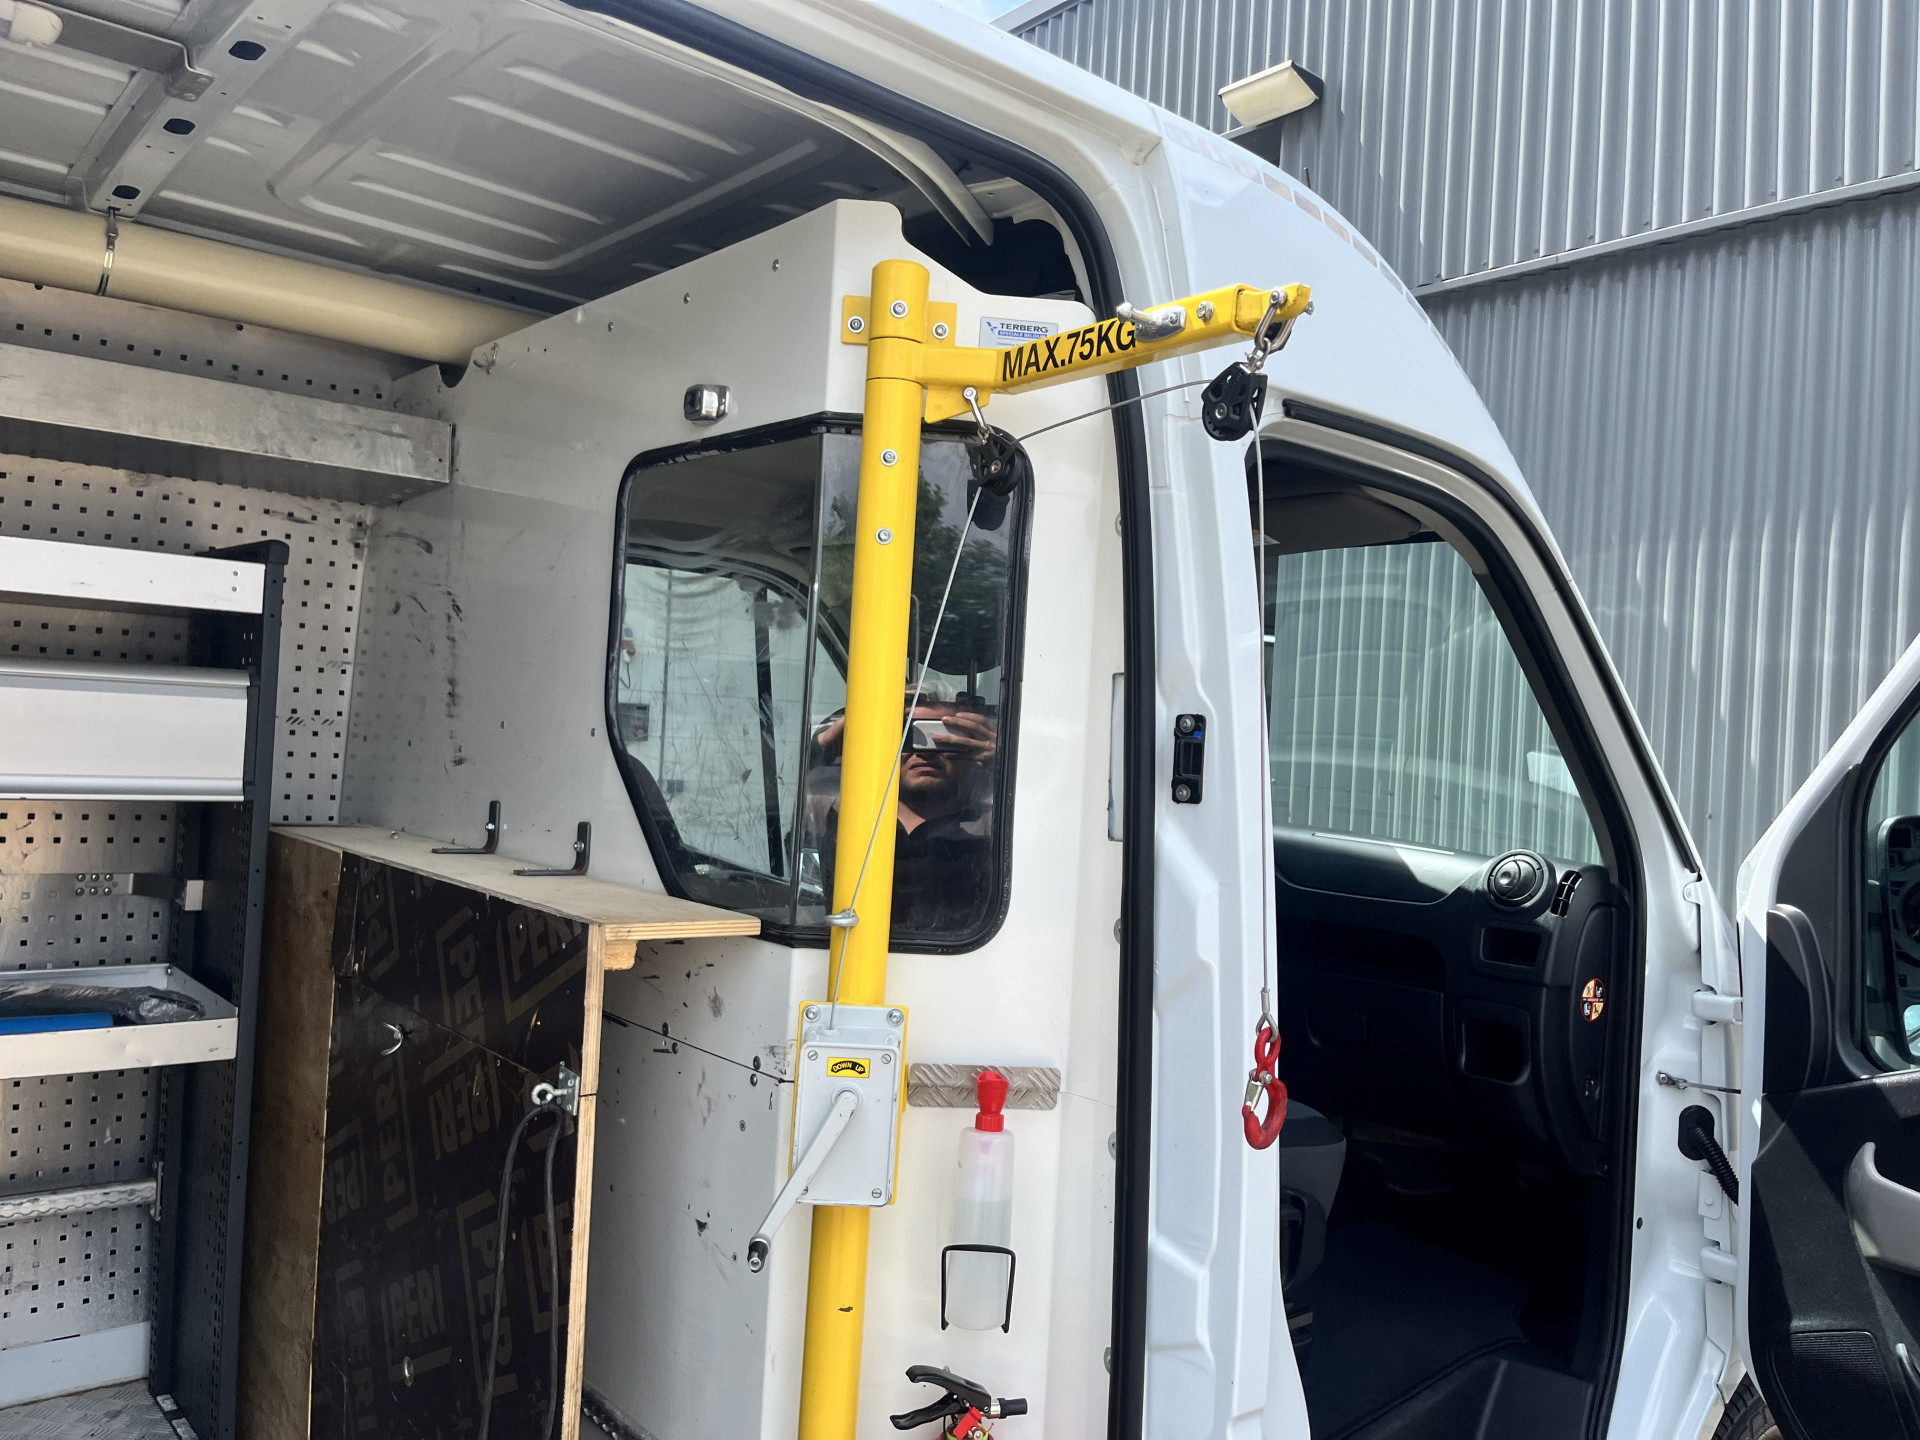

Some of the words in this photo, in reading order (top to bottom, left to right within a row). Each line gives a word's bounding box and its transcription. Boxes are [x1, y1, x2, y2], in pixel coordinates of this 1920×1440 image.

[999, 322, 1049, 333] TERBERG
[1002, 319, 1136, 382] MAX.75KG
[832, 1061, 853, 1072] DOWN
[855, 1064, 865, 1072] UP
[388, 1262, 446, 1349] PERI
